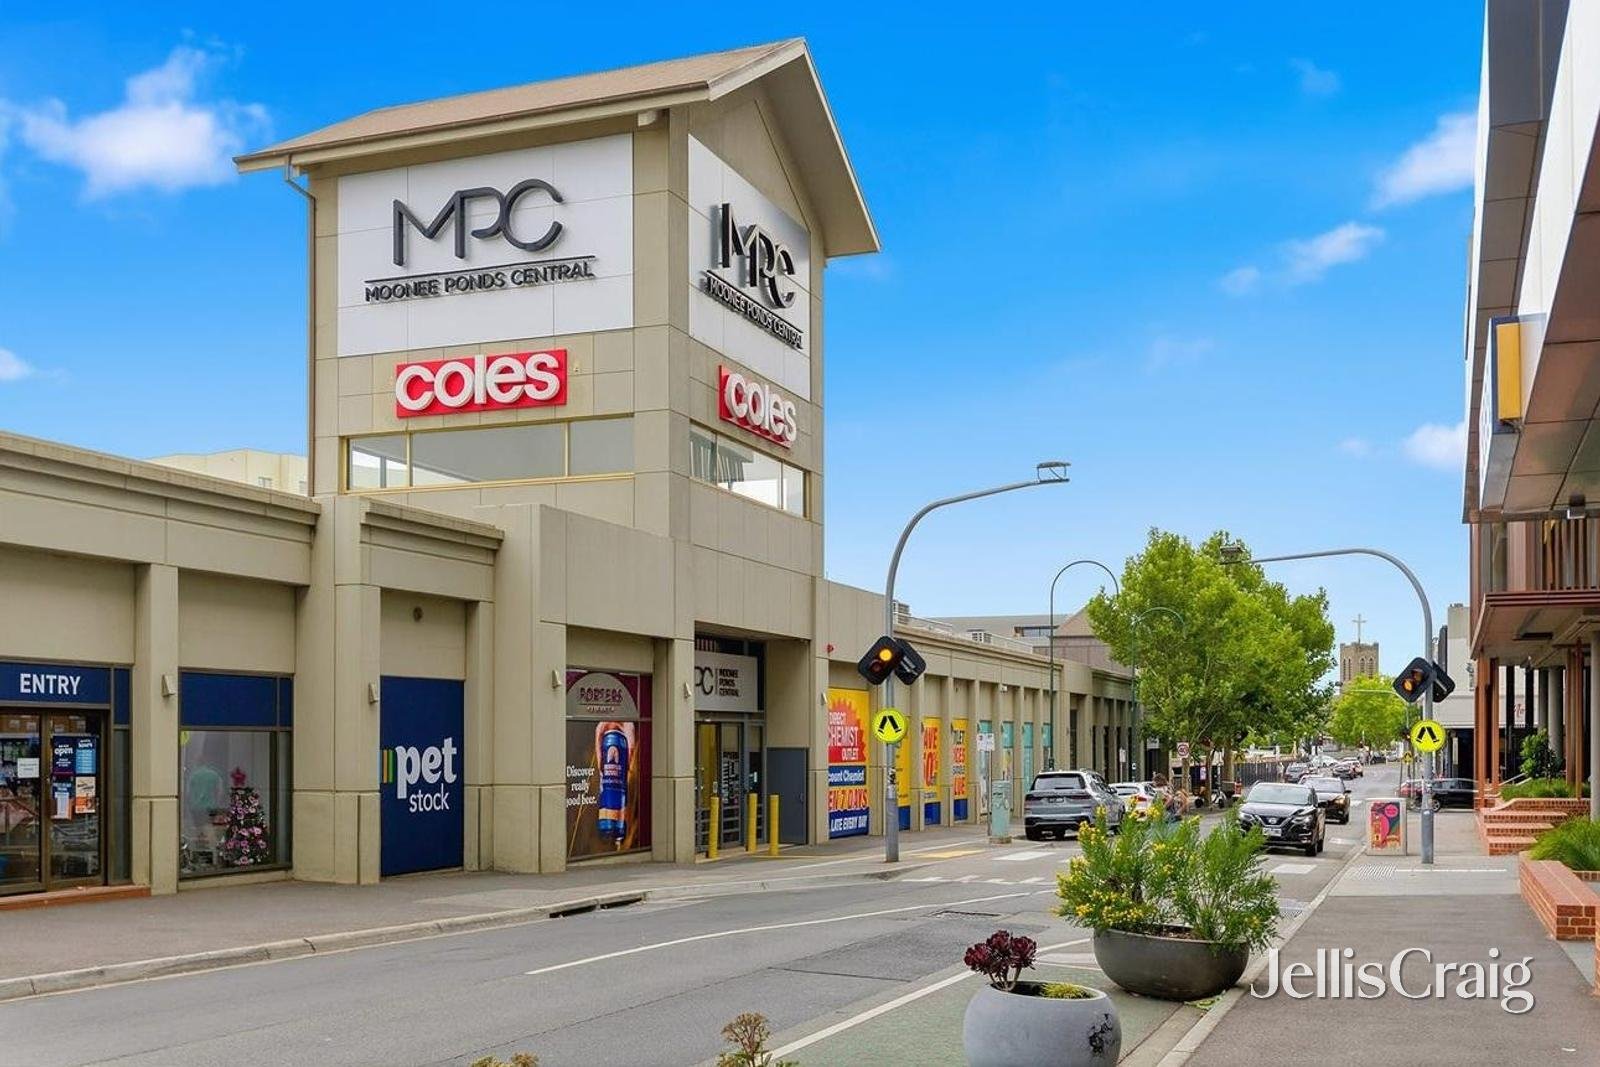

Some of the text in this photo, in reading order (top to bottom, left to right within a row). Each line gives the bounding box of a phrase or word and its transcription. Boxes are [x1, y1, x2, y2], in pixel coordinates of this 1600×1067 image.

[393, 178, 564, 266] MPC
[365, 261, 595, 302] MOONEE PONDS CENTRAL
[721, 203, 796, 309] MPC
[707, 277, 803, 350] MOONEE PONDS CENTRAL
[395, 353, 560, 411] coles
[724, 372, 797, 442] coles
[20, 673, 81, 695] ENTRY
[395, 737, 457, 799] pet
[566, 765, 595, 777] Discover
[571, 779, 589, 793] really
[409, 783, 450, 813] stock
